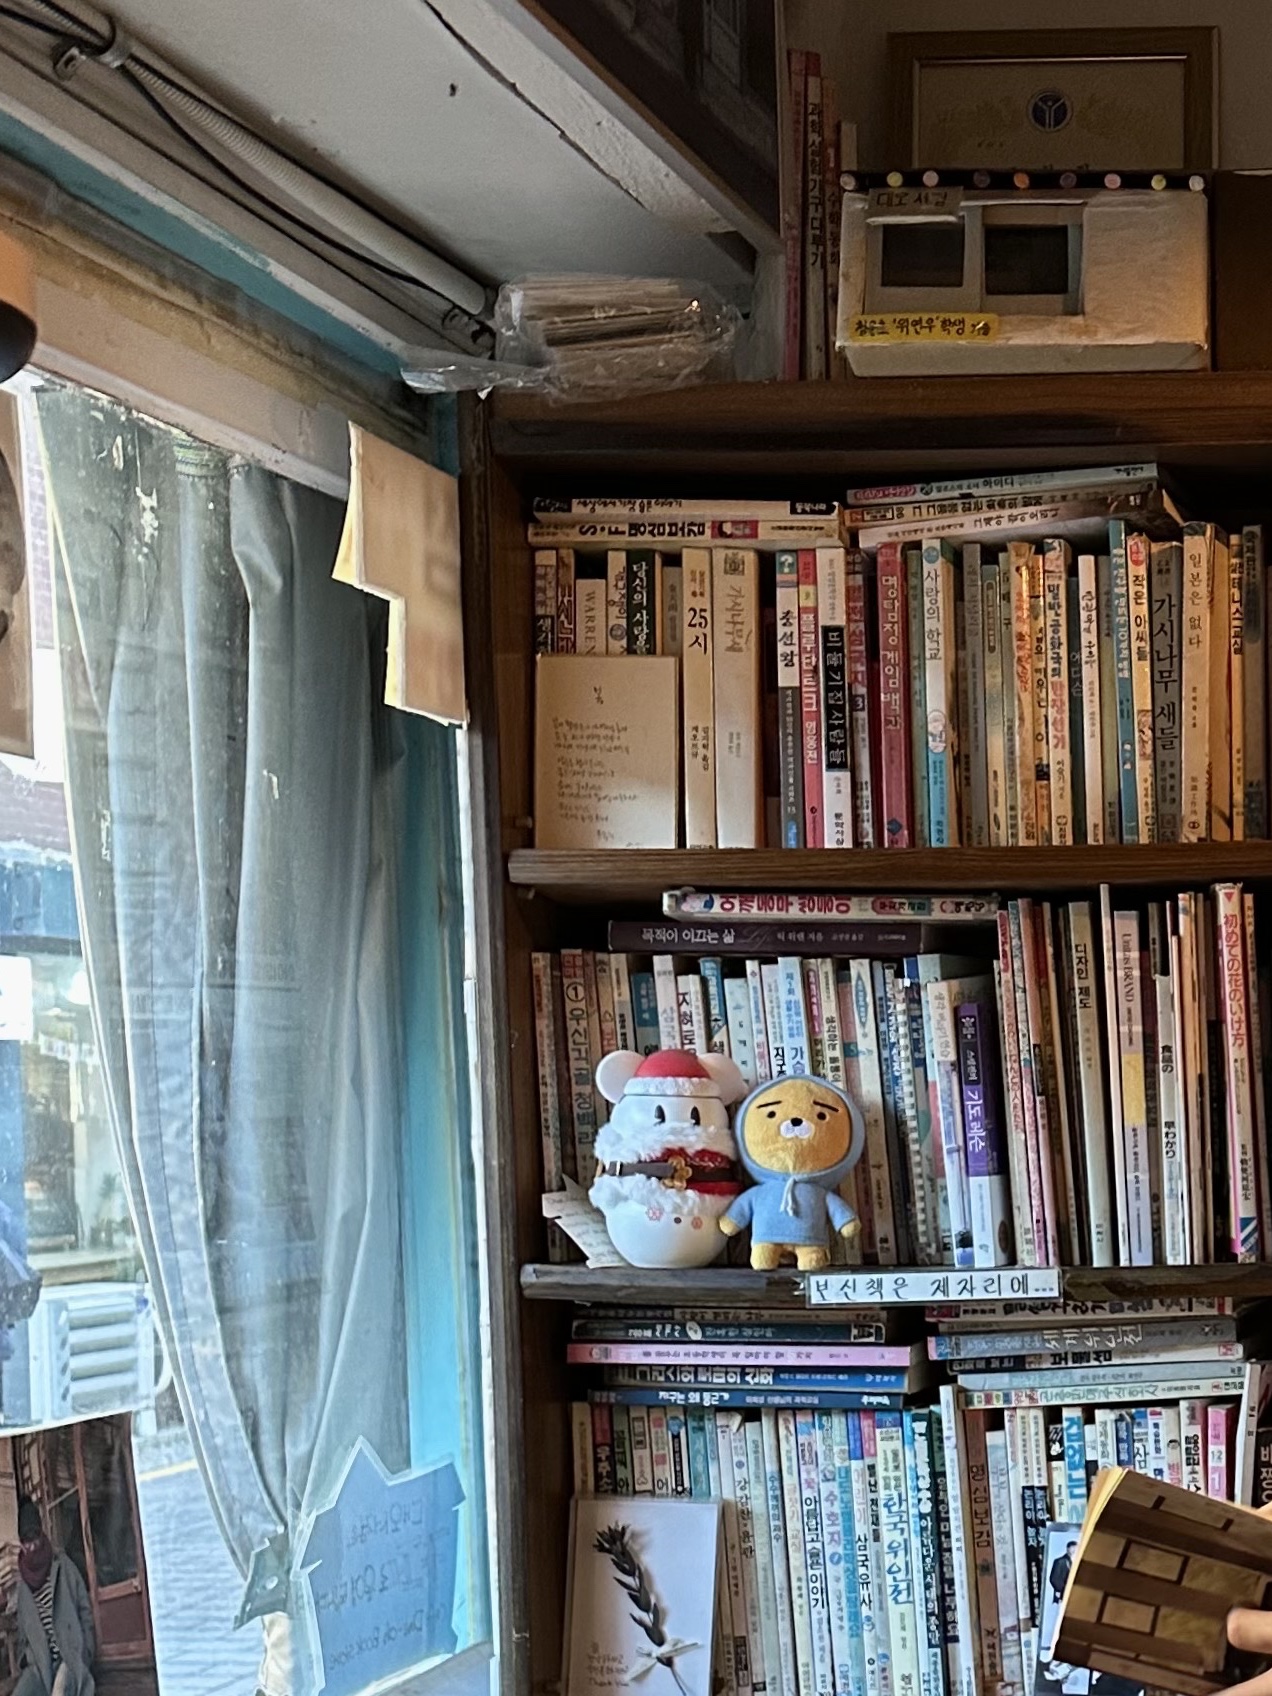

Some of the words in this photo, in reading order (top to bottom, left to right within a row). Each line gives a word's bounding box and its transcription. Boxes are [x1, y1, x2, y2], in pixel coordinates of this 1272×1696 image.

[1153, 592, 1179, 693] 가시나무
[1156, 700, 1179, 752] 새들
[641, 928, 679, 944] 목적이
[882, 1495, 914, 1607] 한국위인전
